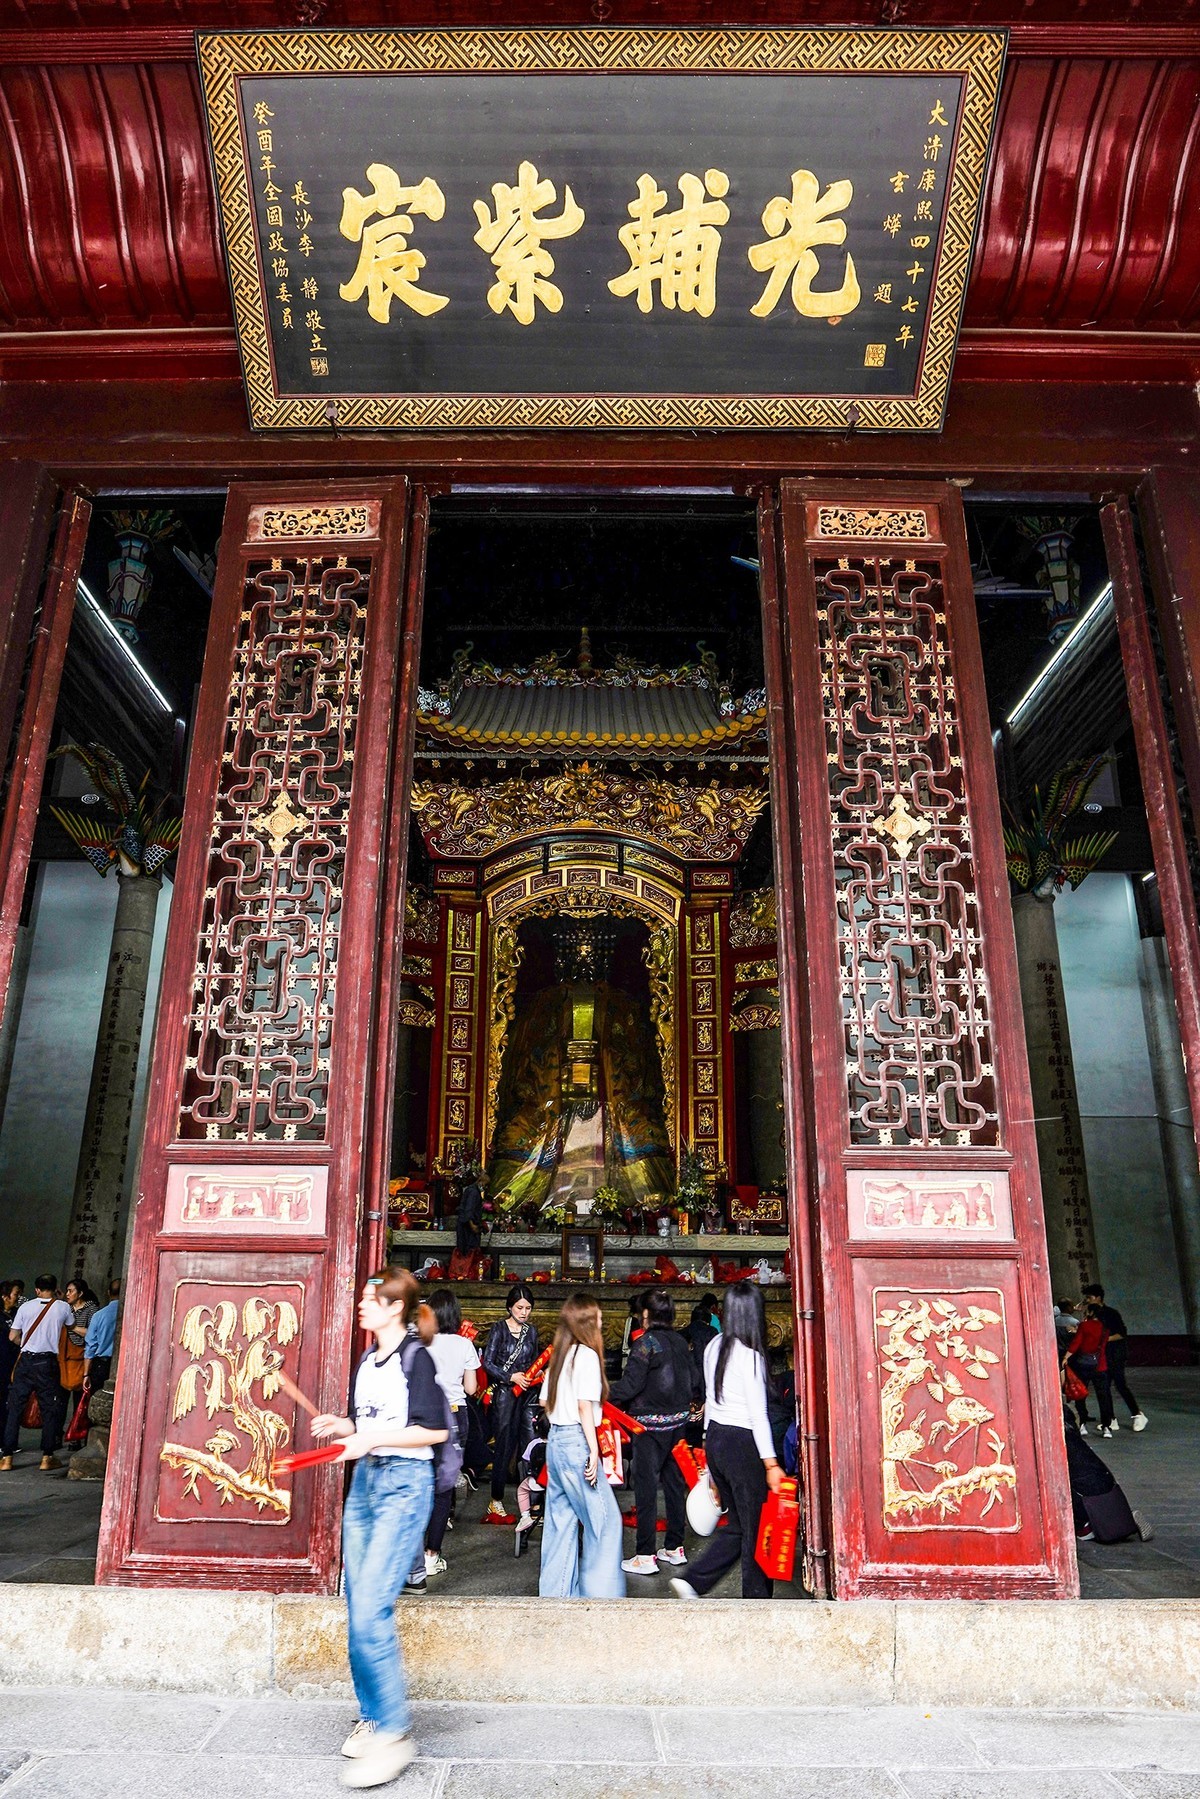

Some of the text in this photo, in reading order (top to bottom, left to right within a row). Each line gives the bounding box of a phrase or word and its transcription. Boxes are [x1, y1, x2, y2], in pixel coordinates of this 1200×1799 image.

[895, 99, 948, 349] 大清康熙四十七年
